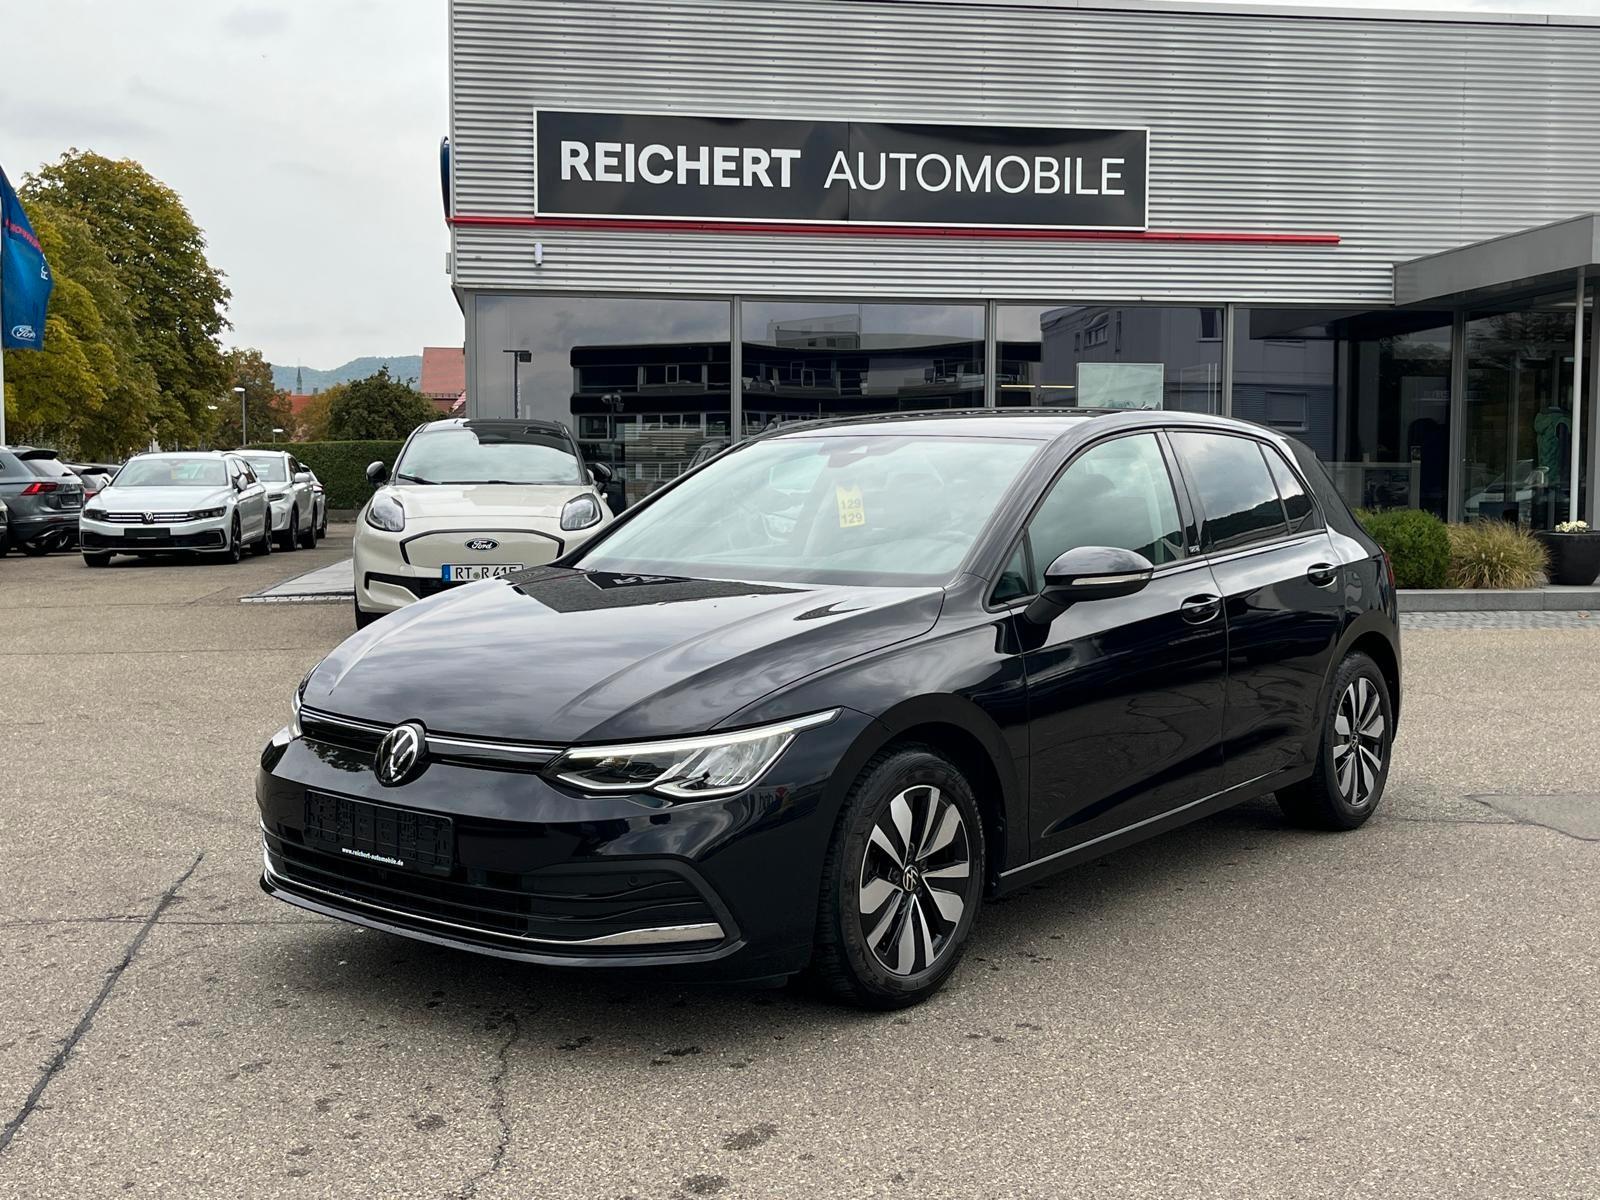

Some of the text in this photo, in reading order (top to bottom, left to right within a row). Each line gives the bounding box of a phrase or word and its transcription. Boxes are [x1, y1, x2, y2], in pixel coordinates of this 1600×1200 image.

[560, 140, 1125, 196] REICHERT AUTOMOBILE
[842, 499, 860, 509] 129
[842, 513, 862, 524] 129
[471, 540, 493, 550] Ford
[455, 567, 472, 579] RT
[341, 847, 404, 867] www.reichert-automobile.de
